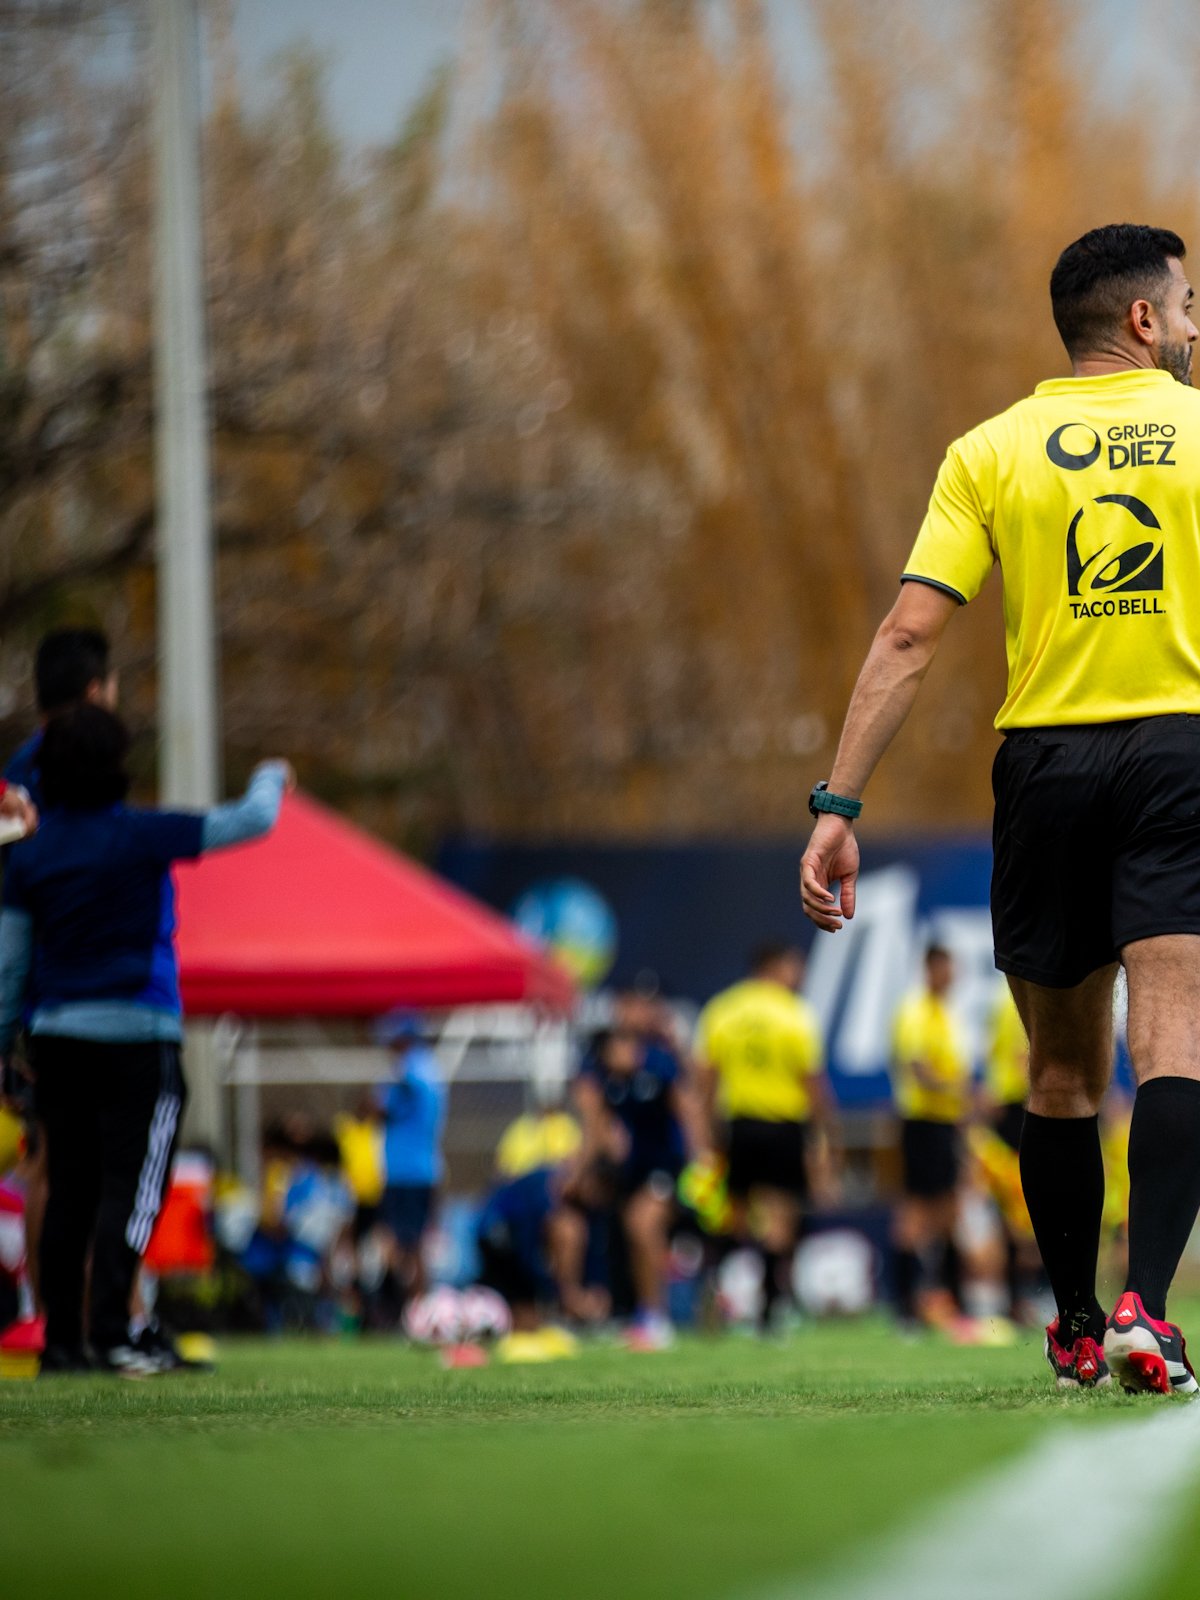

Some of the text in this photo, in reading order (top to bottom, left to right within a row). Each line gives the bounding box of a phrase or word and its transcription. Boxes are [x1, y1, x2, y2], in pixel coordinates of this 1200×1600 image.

[1107, 423, 1176, 441] GRUPO
[1108, 440, 1176, 470] DIEZ
[1069, 600, 1115, 619] TACO
